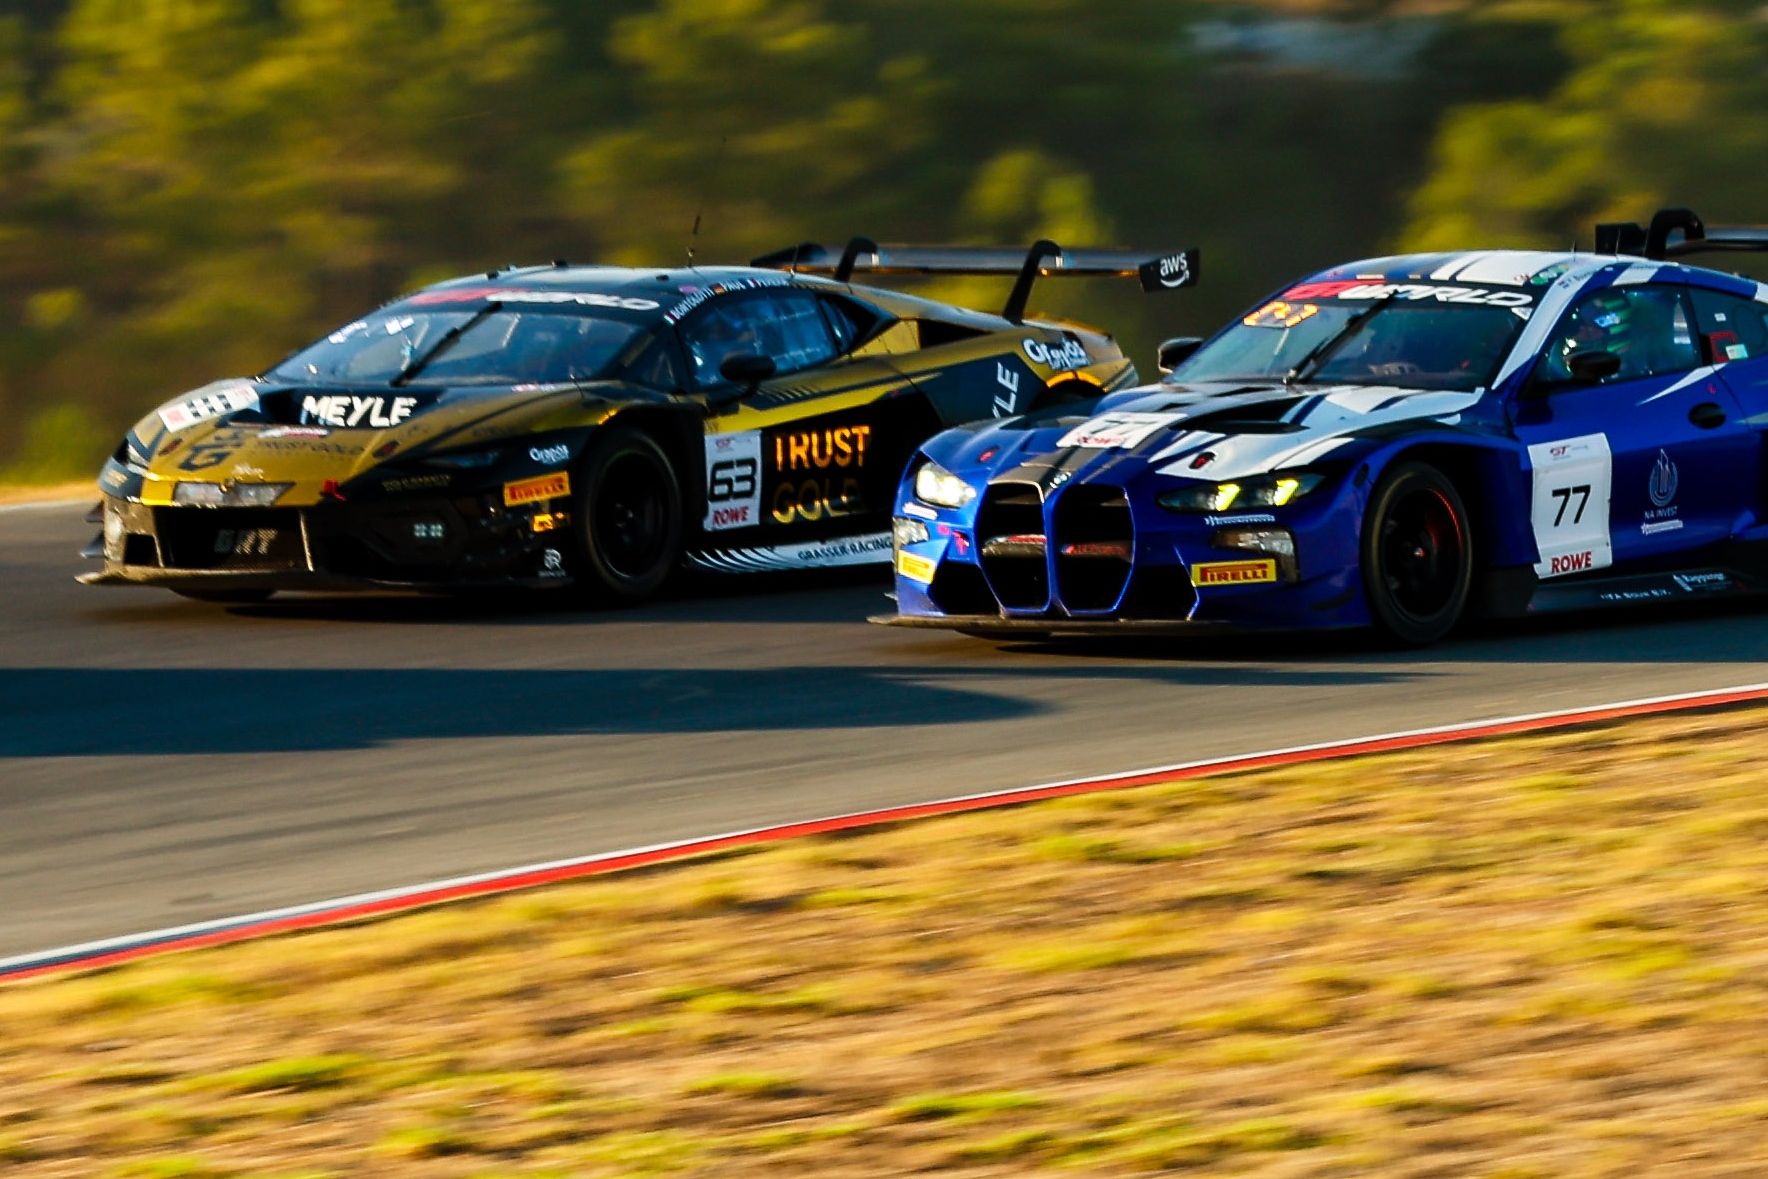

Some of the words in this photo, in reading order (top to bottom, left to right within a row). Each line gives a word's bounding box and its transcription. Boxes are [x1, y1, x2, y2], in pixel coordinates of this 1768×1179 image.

[1160, 252, 1187, 277] aws
[302, 395, 418, 427] MEYLE
[709, 458, 757, 502] 63
[713, 506, 749, 525] ROWE
[1552, 484, 1591, 527] 77
[1201, 563, 1268, 582] PIRELLI
[1551, 551, 1592, 573] ROWE
